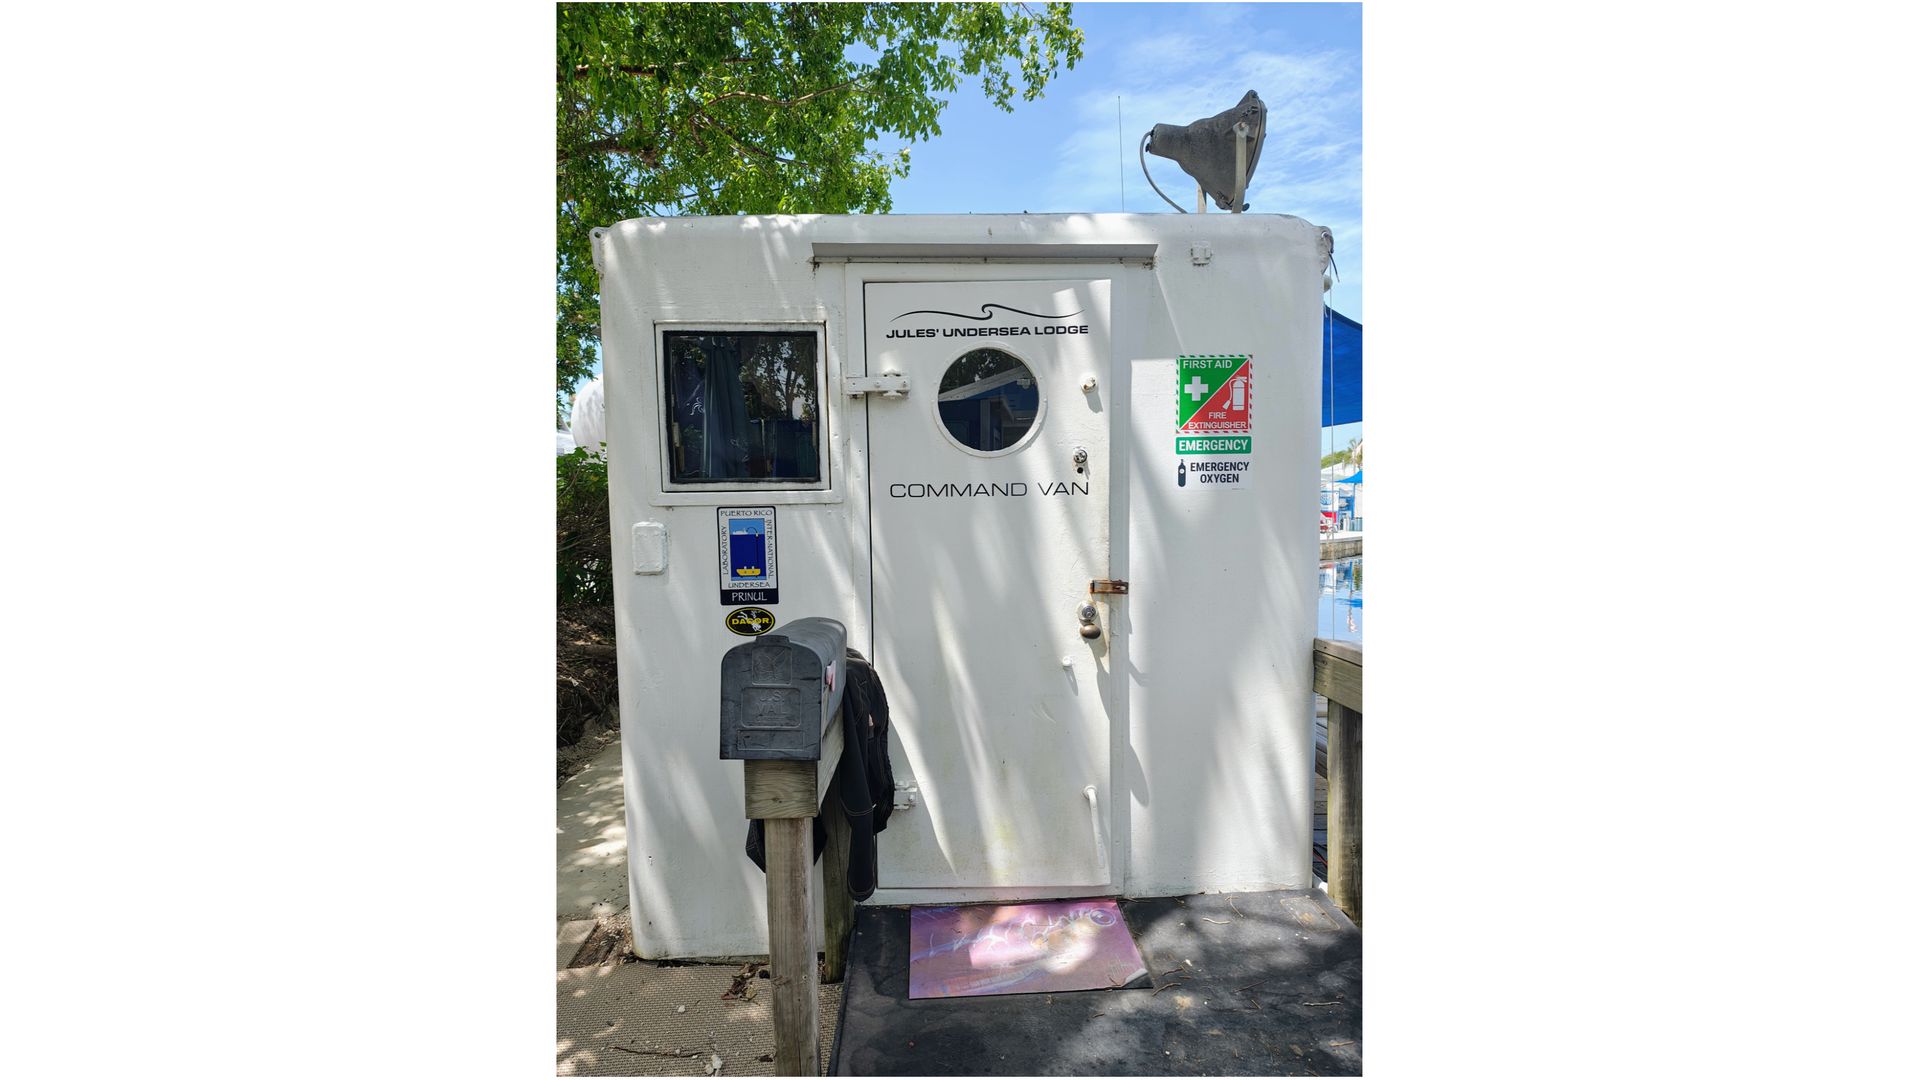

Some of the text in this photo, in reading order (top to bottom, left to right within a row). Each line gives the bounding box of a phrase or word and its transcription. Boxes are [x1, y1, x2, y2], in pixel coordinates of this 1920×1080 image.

[886, 325, 1089, 339] JULES' UNDERSEA LODGE
[1183, 360, 1233, 369] FIRST AID
[1208, 411, 1227, 420] FIRE
[1188, 421, 1247, 429] EXTINGUISHER
[1179, 439, 1248, 451] EMERGENCY
[1190, 461, 1250, 472] EMERGENCY
[1200, 473, 1239, 483] OXYGEN
[890, 481, 1089, 498] COMMAND VAN
[731, 592, 768, 602] PRINUL
